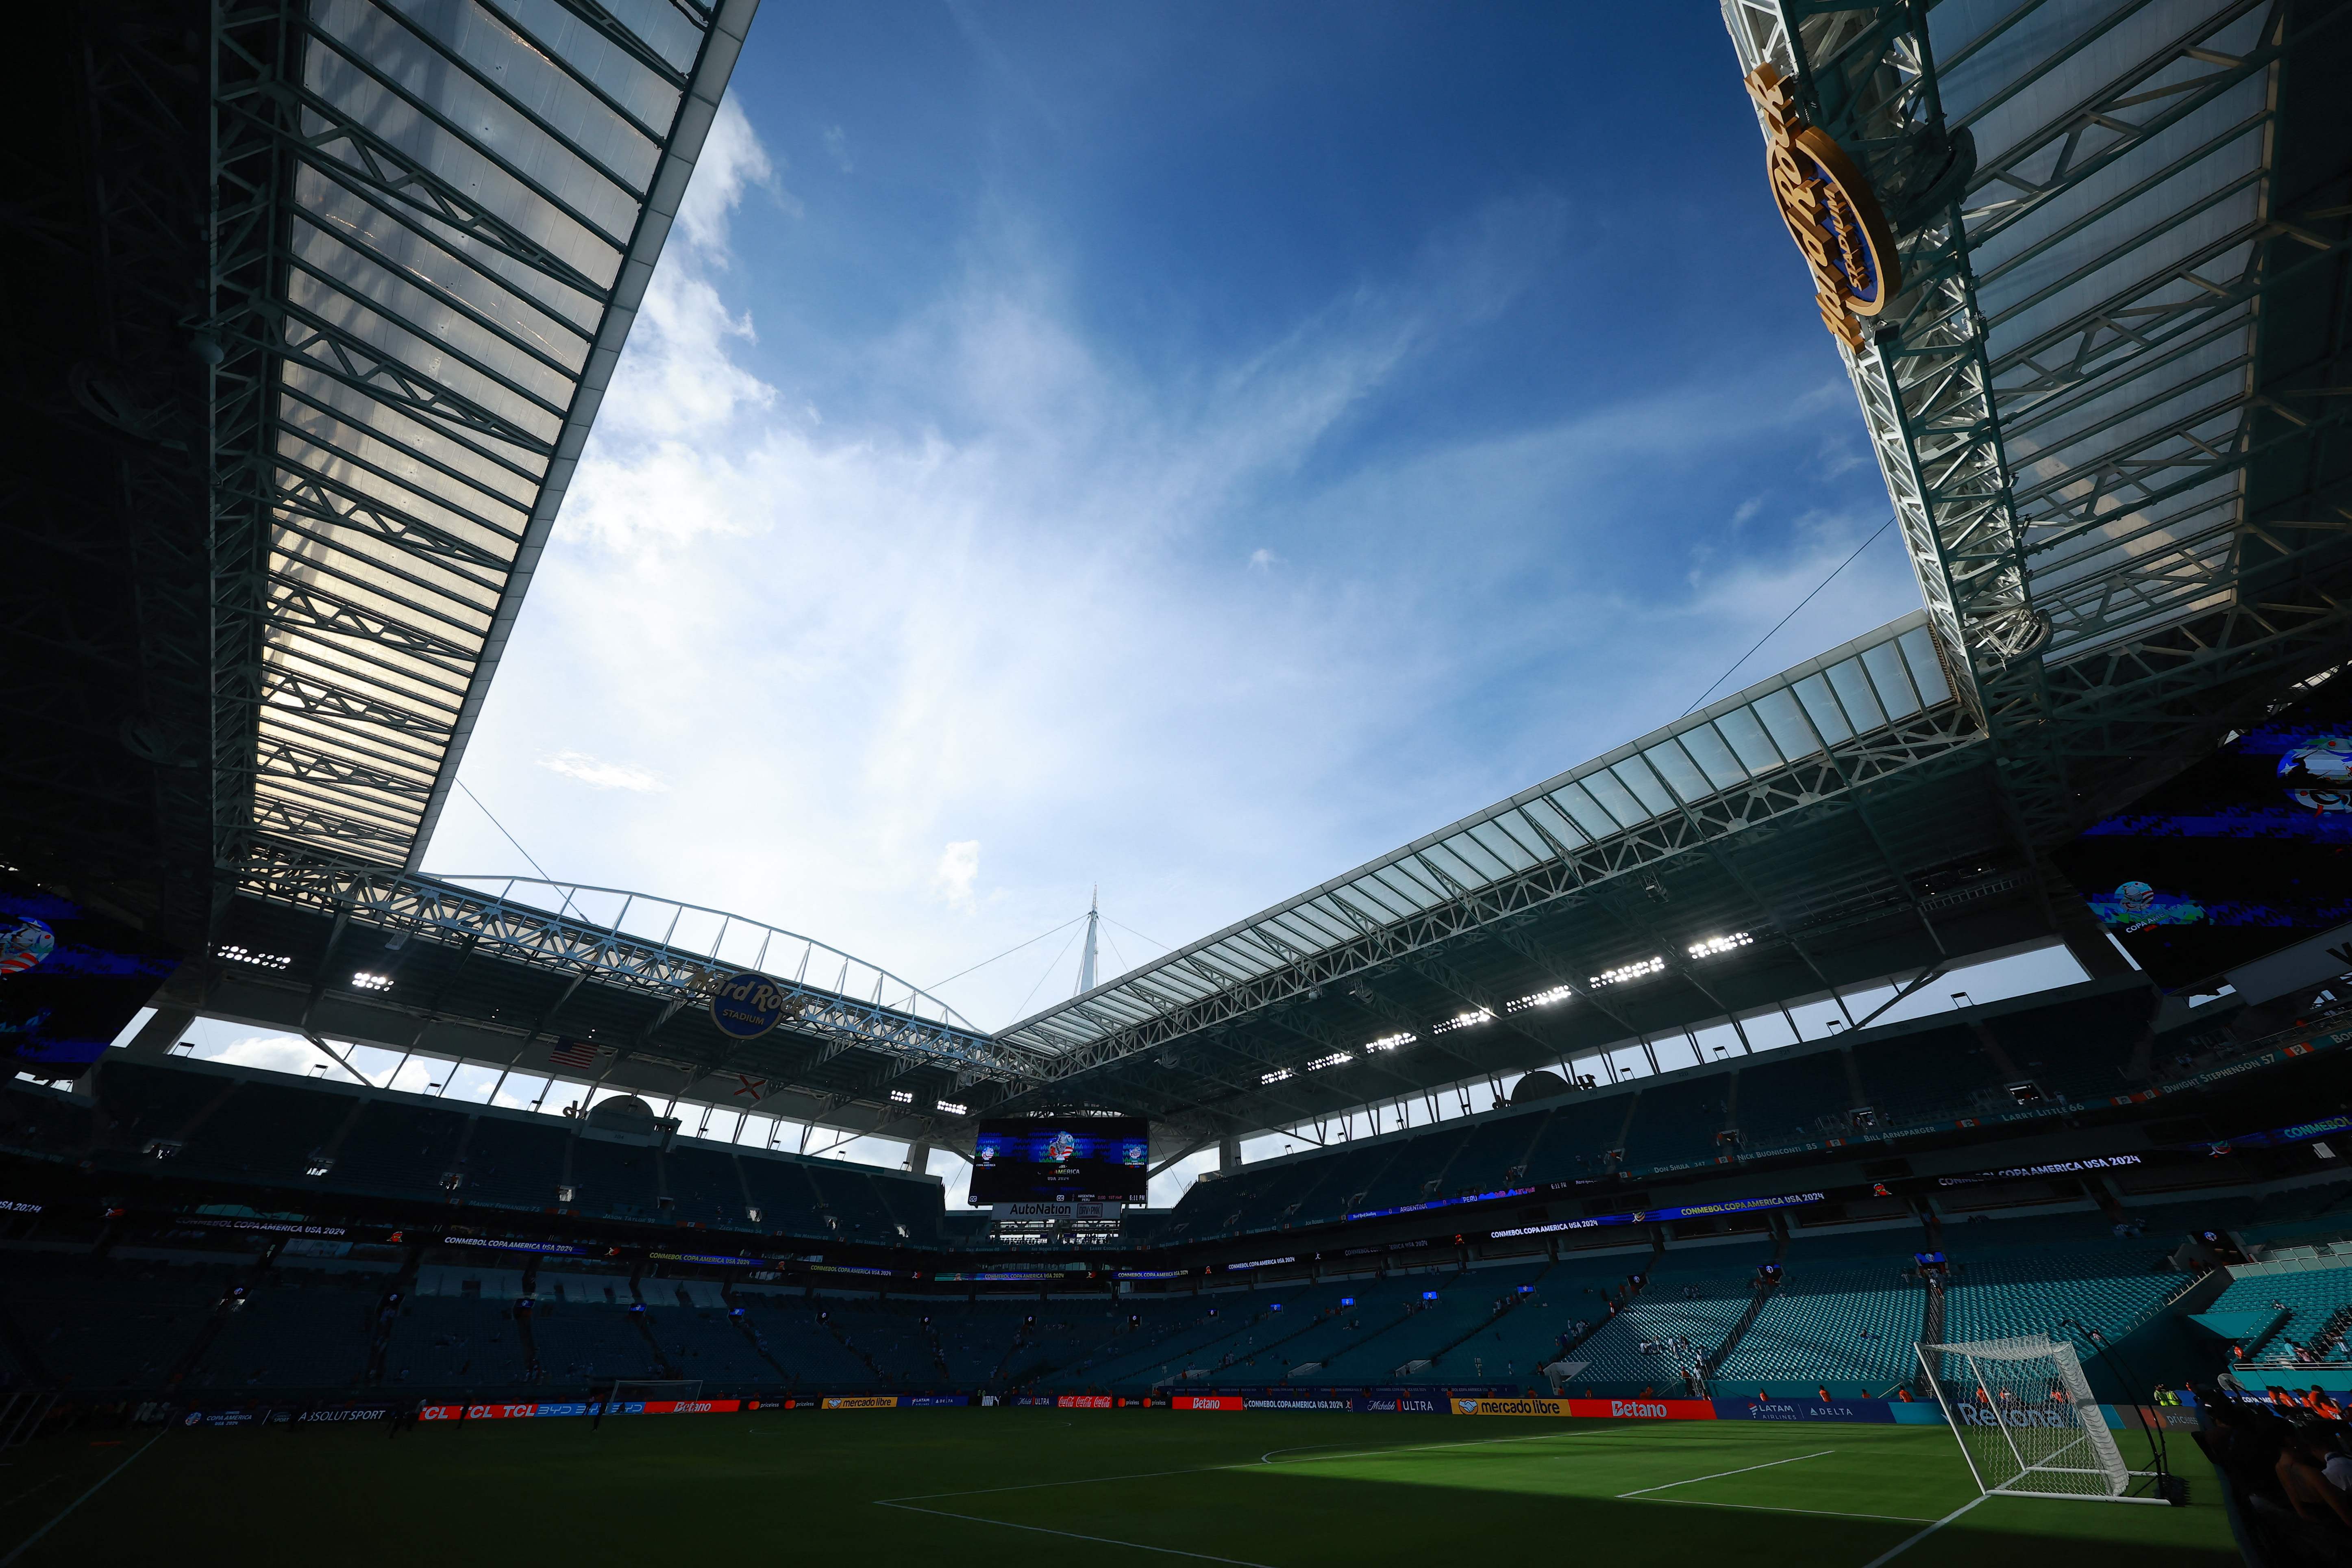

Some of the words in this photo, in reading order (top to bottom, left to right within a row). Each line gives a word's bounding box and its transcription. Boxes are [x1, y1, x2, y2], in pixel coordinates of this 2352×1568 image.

[1744, 65, 1824, 227] Rock
[1823, 183, 1867, 291] STADIUM
[1787, 207, 1865, 356] Hard
[2126, 920, 2147, 933] COPA
[688, 968, 756, 1001] Hard
[751, 984, 807, 1021] Rock
[722, 1009, 765, 1025] STADIUM
[2165, 1078, 2200, 1094] DWIGHT
[2202, 1060, 2261, 1084] STEPHENSON
[2260, 1053, 2275, 1065] 57
[2001, 1111, 2033, 1122] LARRY
[2036, 1107, 2068, 1118] LITTLE
[2069, 1103, 2085, 1112] 66
[1864, 1133, 1881, 1142] BILL
[1883, 1126, 1936, 1140] ARNSPARGER
[2284, 1116, 2352, 1138] CONMEBOL
[1737, 1153, 1754, 1162] NICK
[1756, 1146, 1802, 1158] BUONICONTI
[1806, 1143, 1818, 1151] 85
[1654, 1166, 1669, 1174] DON
[1669, 1163, 1690, 1172] SHULA
[2031, 1161, 2084, 1176] AMERICA
[2083, 1158, 2109, 1168] USA
[2108, 1155, 2141, 1166] 2024
[1463, 1195, 1477, 1203] PERU
[1681, 1205, 1725, 1216] CONMEBOL
[1724, 1202, 1745, 1211] COPA
[1745, 1197, 1784, 1209] AMERICA
[1784, 1194, 1803, 1203] USA
[1802, 1192, 1825, 1202] 2024
[1010, 1204, 1071, 1215] AutoNation
[1400, 1203, 1428, 1213] ARGENTINA
[233, 1220, 260, 1229] COPA
[260, 1223, 302, 1233] AMERICA
[322, 1227, 345, 1235] 2024
[1490, 1229, 1524, 1238] CONMEBOL
[1523, 1227, 1540, 1235] COPA
[1540, 1223, 1568, 1232] AMERICA
[1568, 1221, 1582, 1229] USA
[1582, 1219, 1598, 1228] 2024
[444, 1237, 487, 1246] CONMEBOL
[488, 1240, 508, 1248] COPA
[507, 1242, 541, 1250] AMERICA
[699, 1255, 726, 1264] AMERICA
[674, 1401, 712, 1413] Betano
[843, 1398, 874, 1407] mercado
[876, 1398, 891, 1406] libre
[1193, 1397, 1220, 1409] Betano
[1248, 1400, 1277, 1408] CONMEBOL
[1277, 1400, 1293, 1408] COPA
[1292, 1400, 1317, 1409] AMERICA
[1317, 1400, 1328, 1409] USA
[1329, 1401, 1343, 1409] 2024
[1367, 1401, 1395, 1411] Michelob
[1403, 1401, 1434, 1411] ULTRA
[1482, 1400, 1531, 1414] mercado
[1534, 1399, 1560, 1414] libre
[1612, 1401, 1667, 1418] Betano
[1759, 1404, 1794, 1412] LATAM
[350, 1409, 386, 1420] SPORT
[422, 1406, 448, 1420] CL
[503, 1405, 535, 1418] TCL
